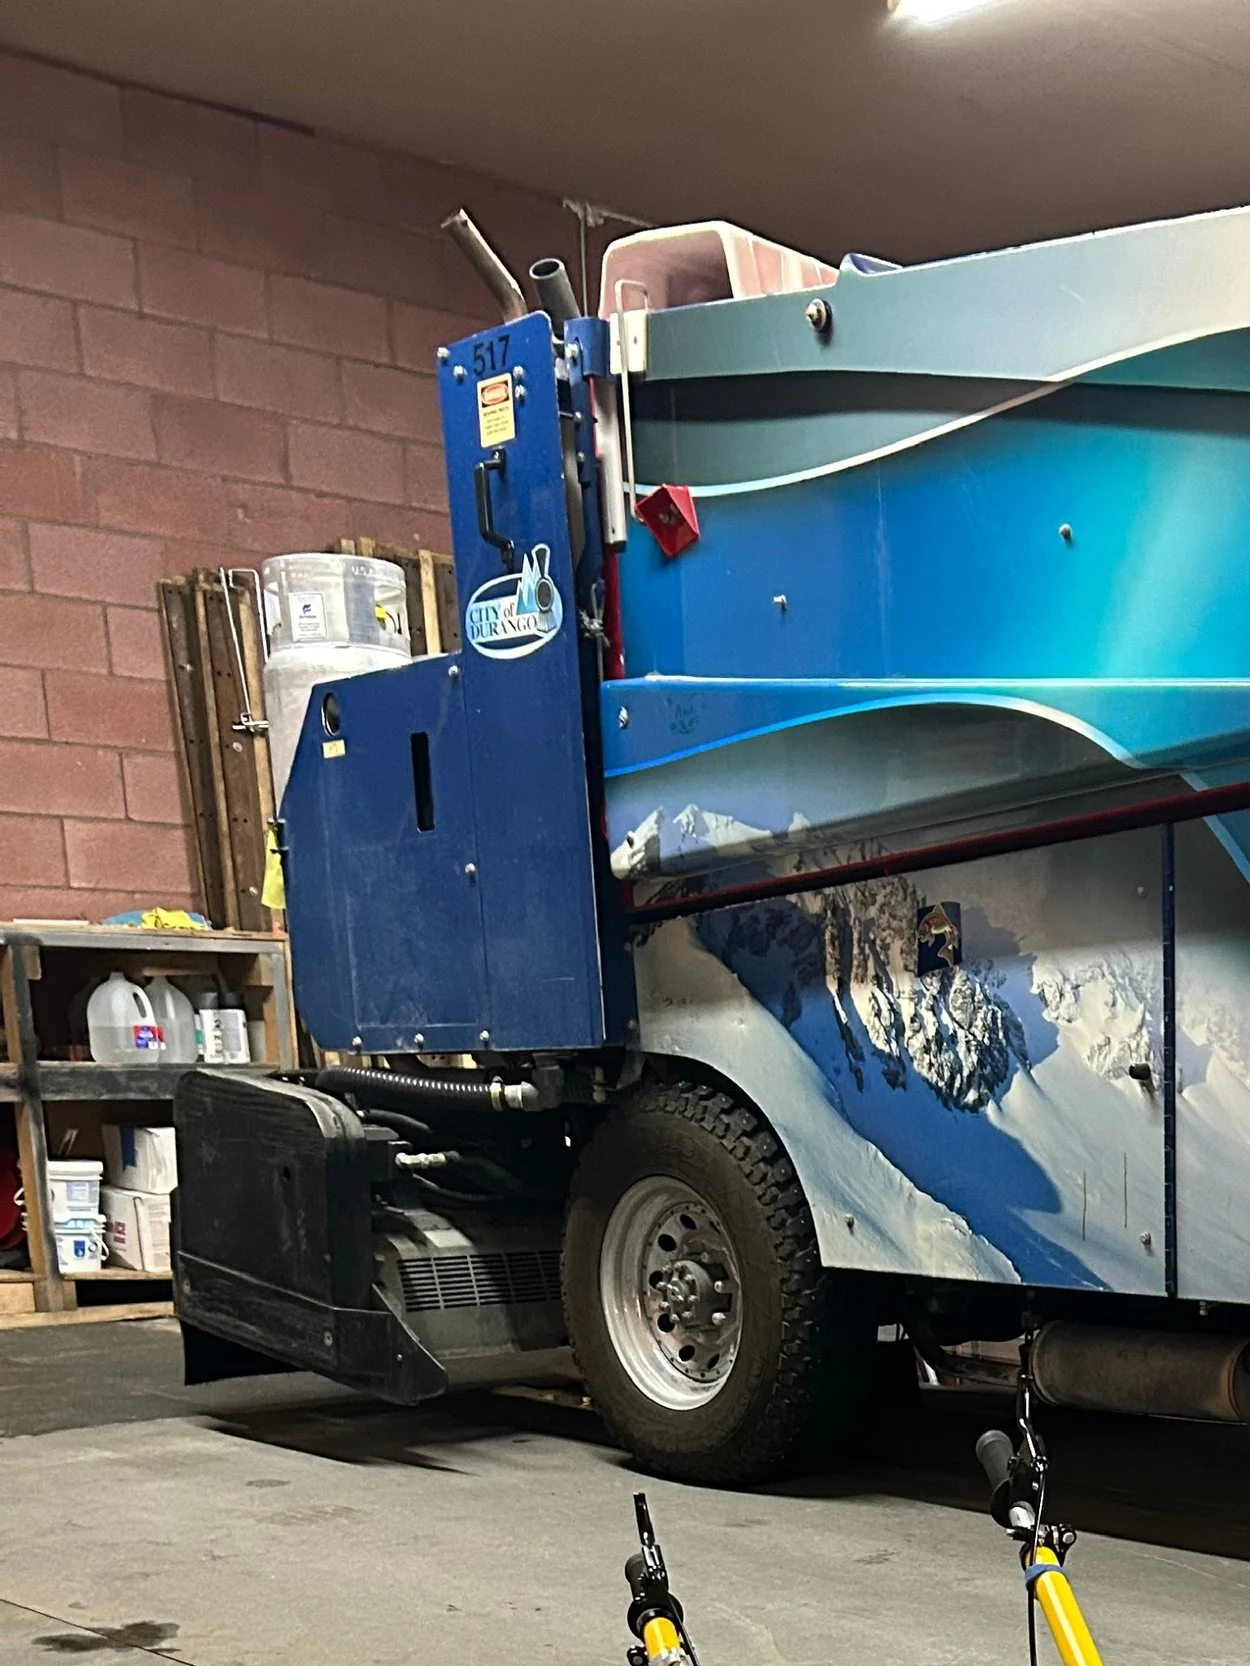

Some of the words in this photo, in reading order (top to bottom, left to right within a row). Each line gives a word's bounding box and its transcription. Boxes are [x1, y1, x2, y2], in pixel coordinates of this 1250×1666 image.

[473, 334, 510, 377] 517
[469, 605, 500, 625] CITY
[503, 602, 515, 619] of
[470, 614, 537, 640] DURANGO
